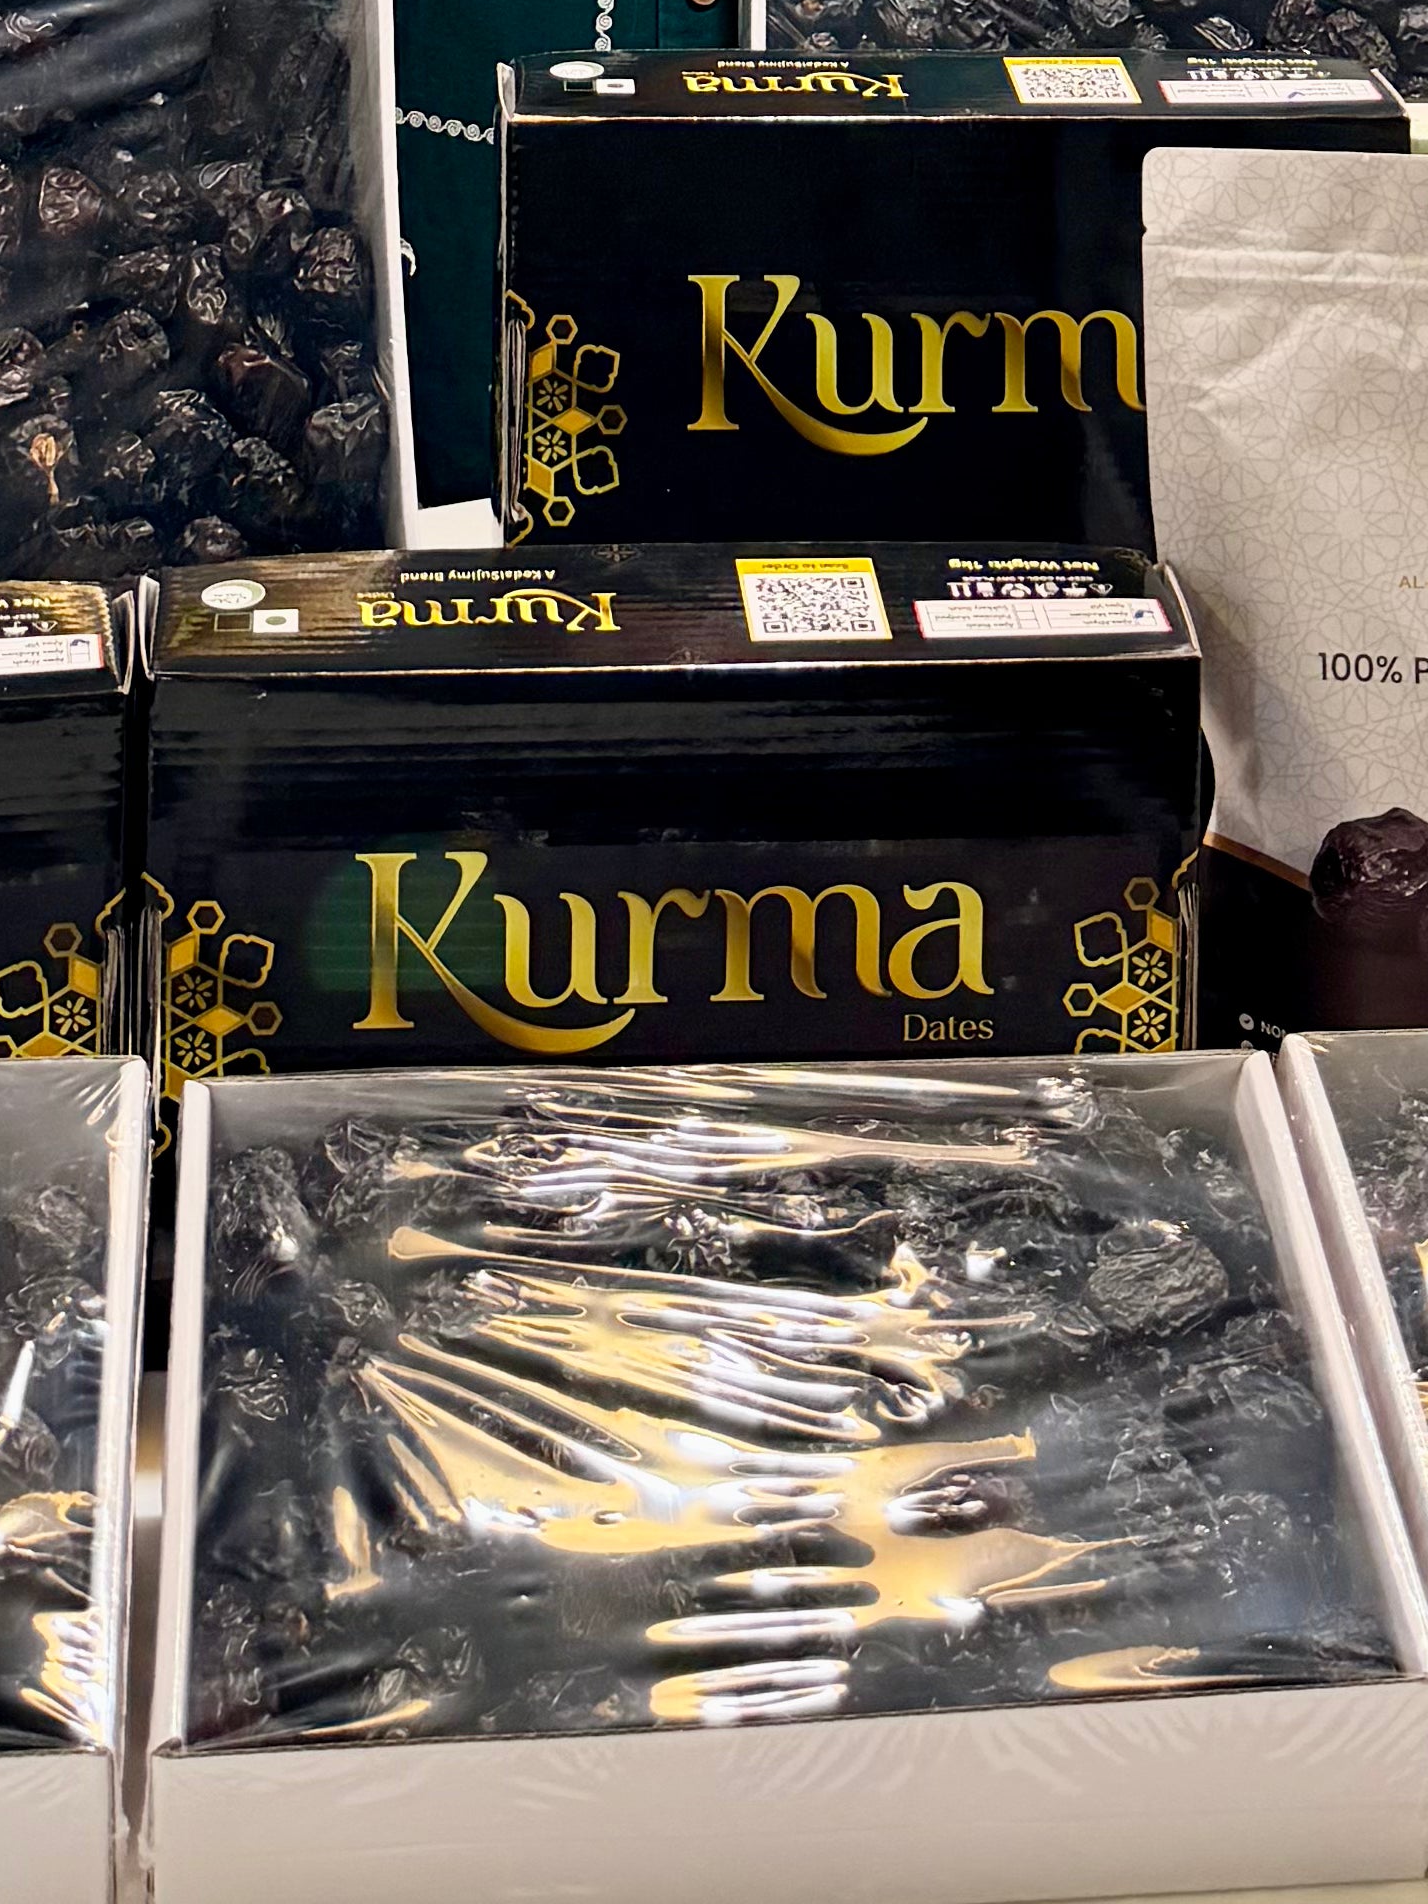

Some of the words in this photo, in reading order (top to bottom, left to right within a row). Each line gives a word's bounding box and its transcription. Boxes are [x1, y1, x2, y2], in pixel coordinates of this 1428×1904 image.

[681, 70, 910, 98] Kurma
[687, 275, 1147, 457] Kurm
[400, 571, 446, 584] Brand
[1062, 560, 1100, 572] Net
[13, 597, 52, 609] Net
[359, 588, 621, 633] Kurma
[1318, 651, 1403, 685] 100%
[353, 849, 995, 1054] Kurma
[902, 1012, 995, 1043] Dates
